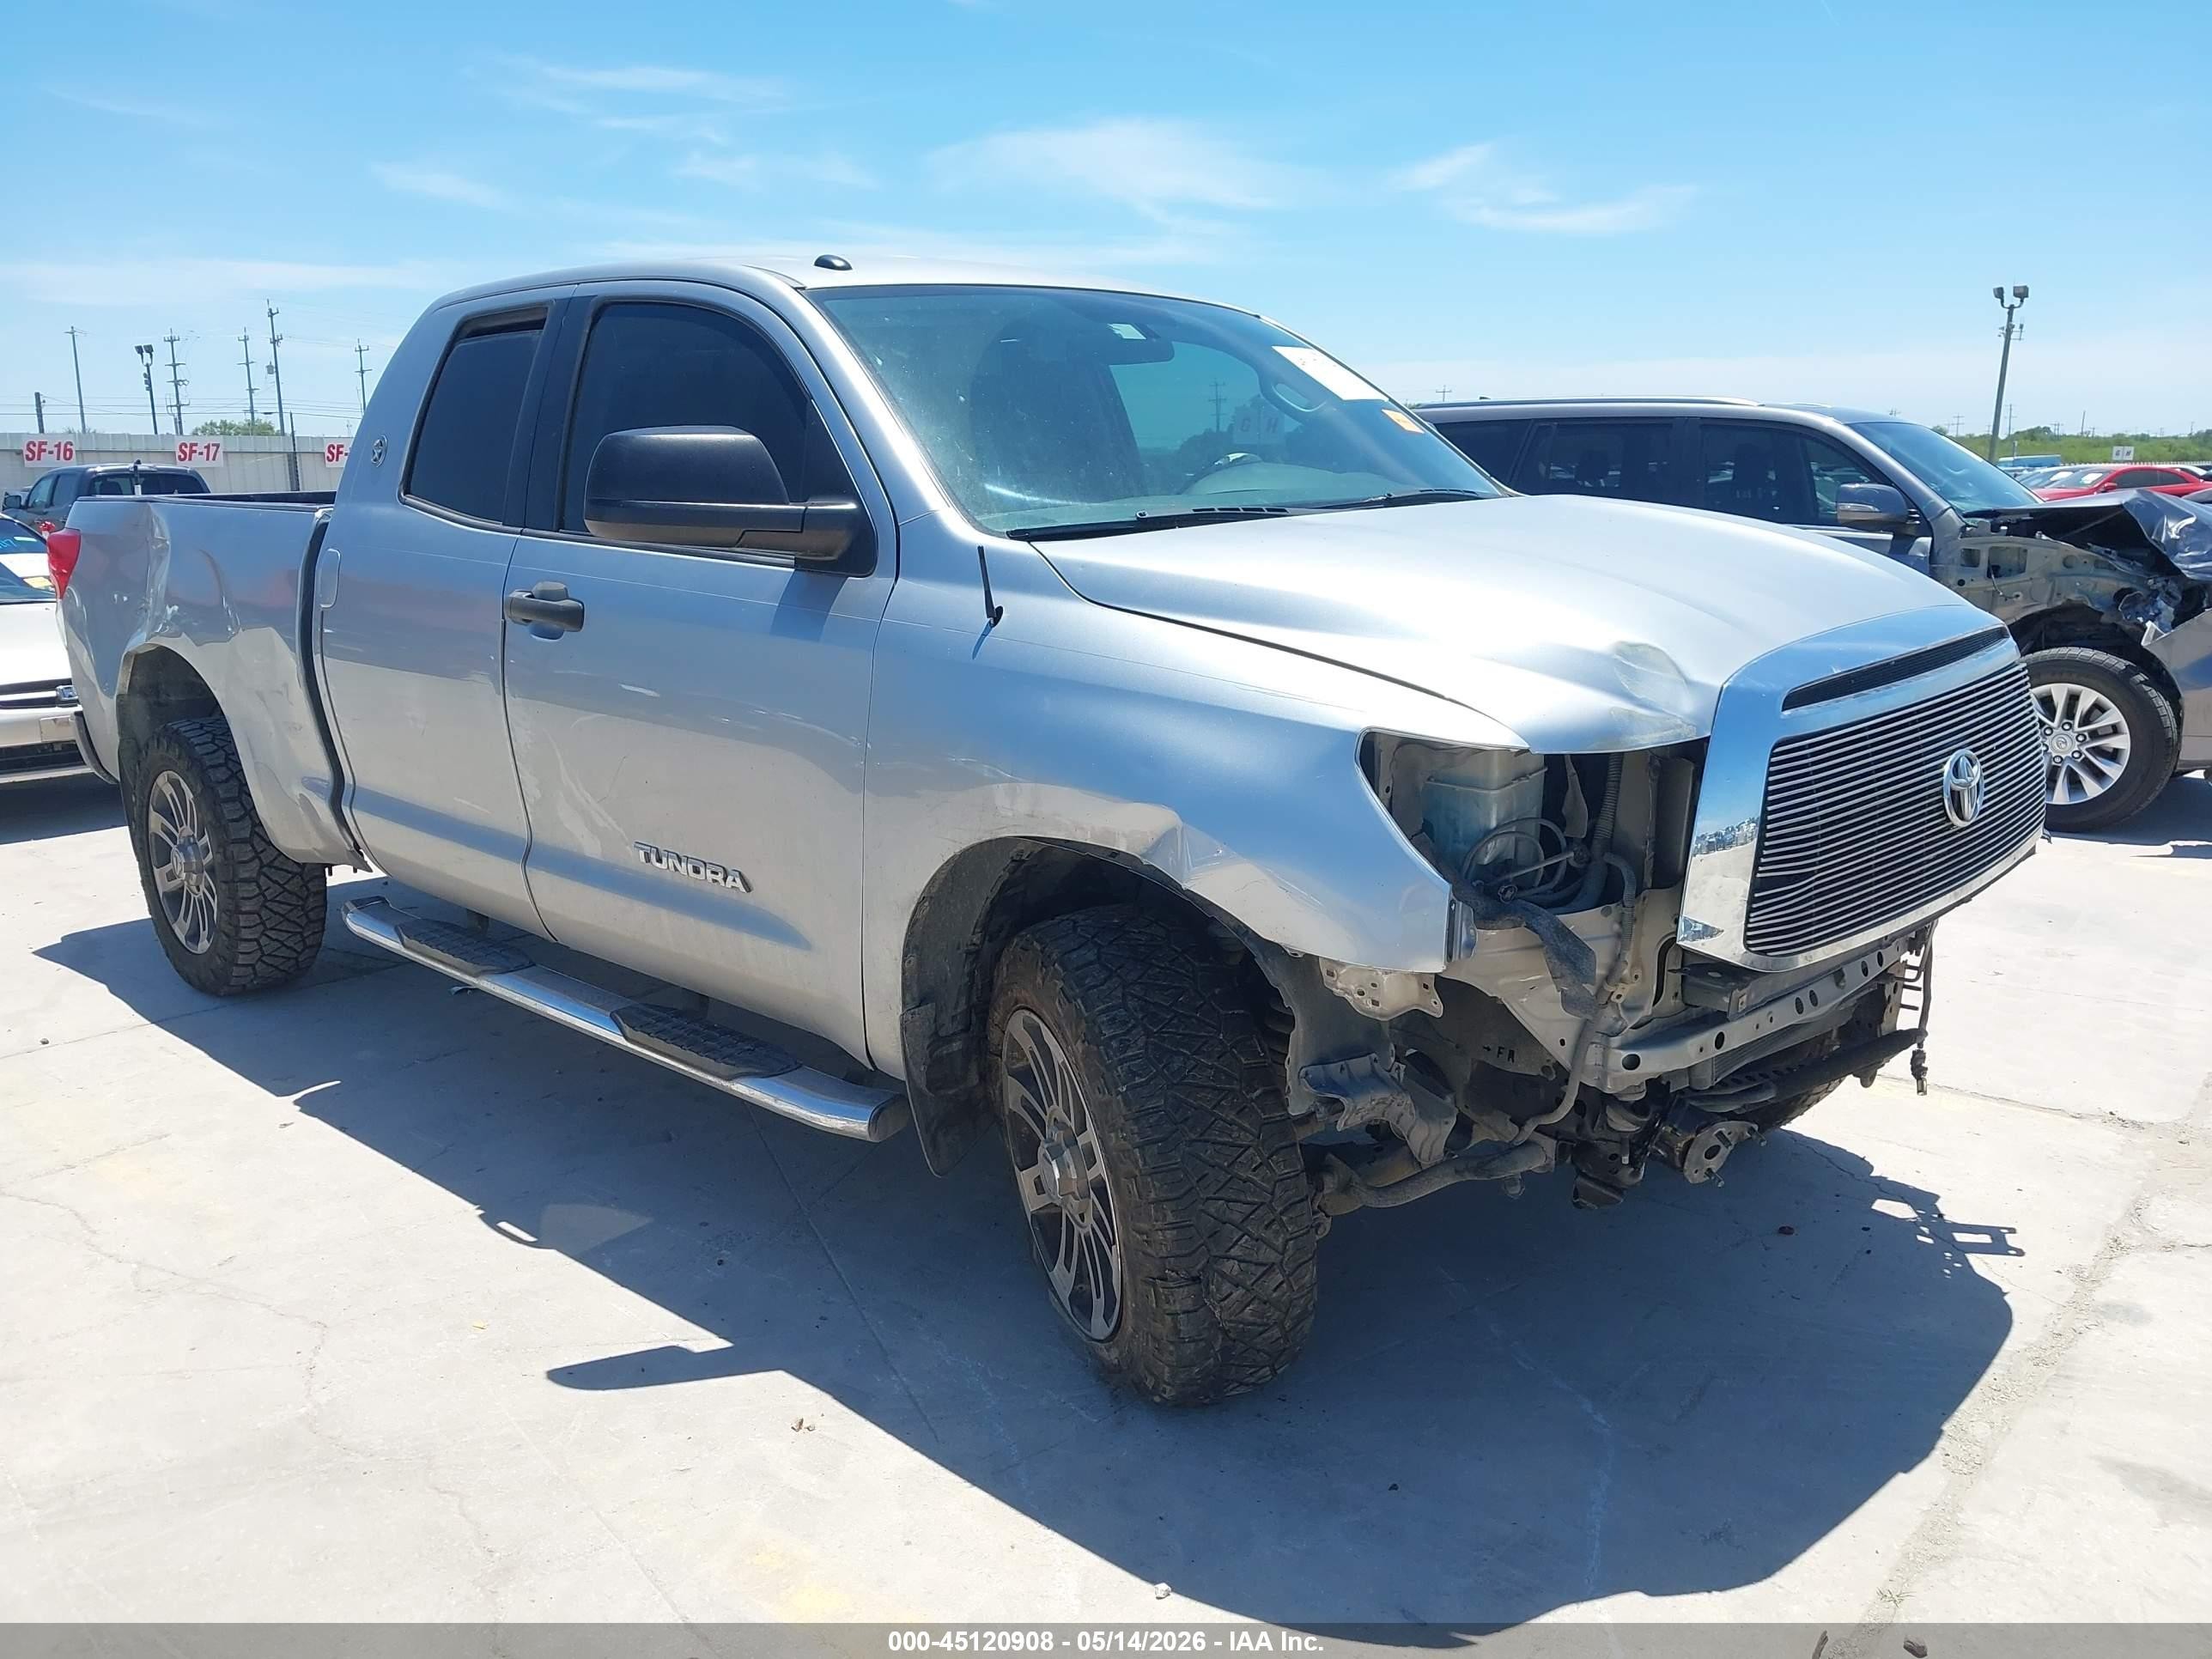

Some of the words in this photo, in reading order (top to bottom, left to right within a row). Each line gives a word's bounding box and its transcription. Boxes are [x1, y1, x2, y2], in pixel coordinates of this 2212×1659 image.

[25, 441, 74, 461] SF-16
[178, 442, 221, 462] SF-17
[634, 841, 752, 894] TUNDRA
